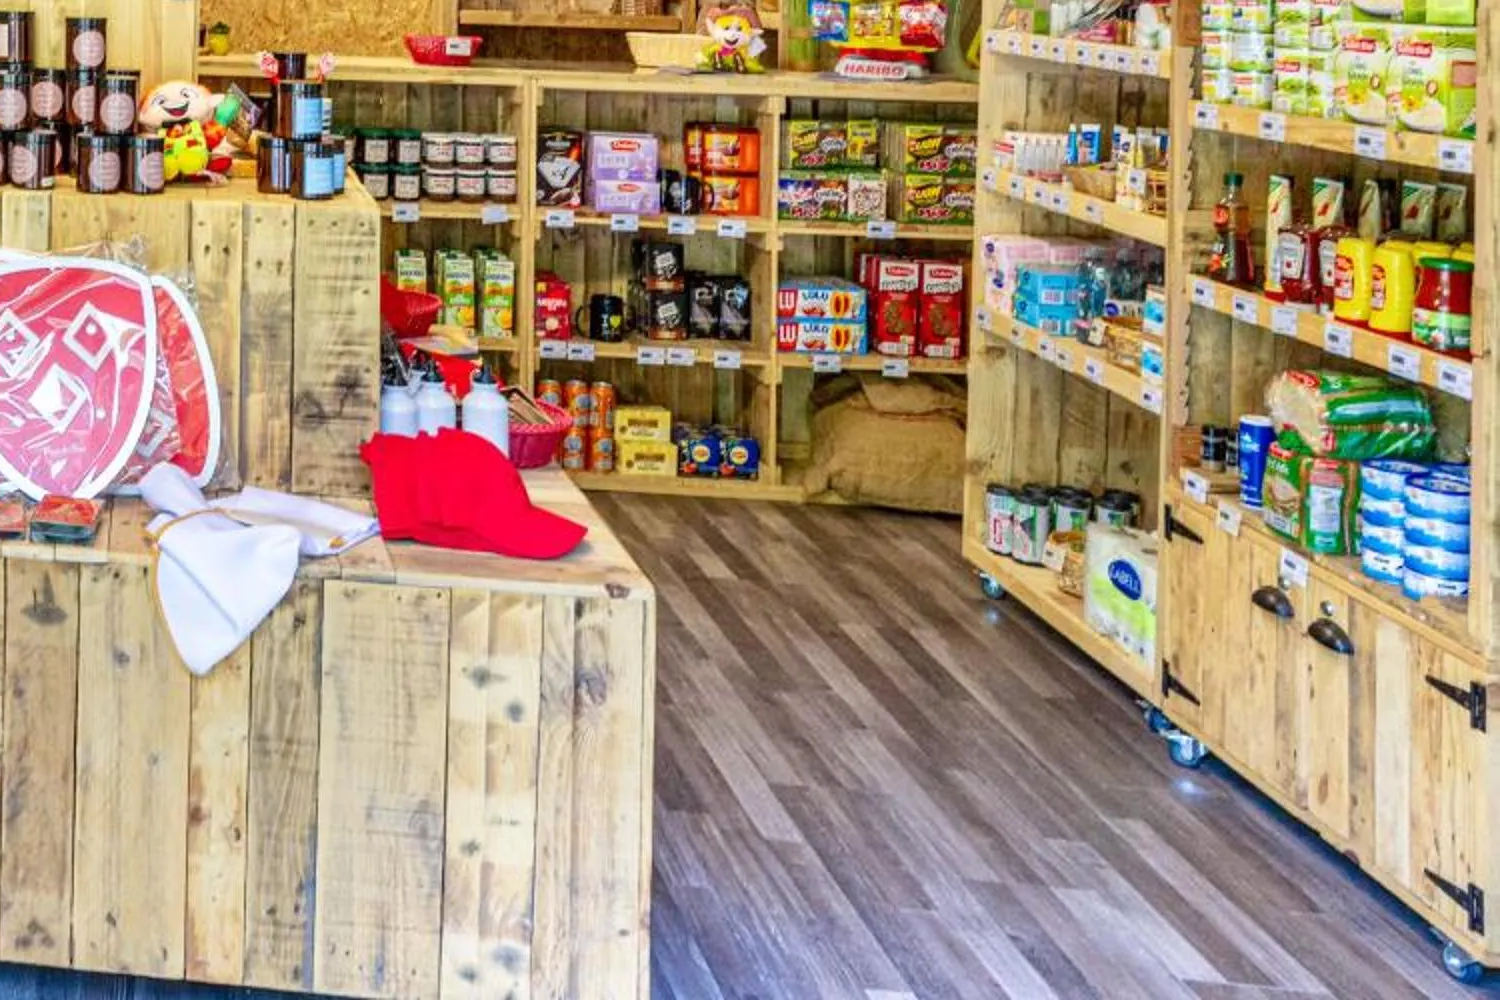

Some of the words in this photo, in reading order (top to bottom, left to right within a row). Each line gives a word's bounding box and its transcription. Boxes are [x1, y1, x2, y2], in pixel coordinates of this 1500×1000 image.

[844, 63, 904, 77] HARIBO
[778, 291, 796, 309] LU
[779, 325, 797, 343] LU
